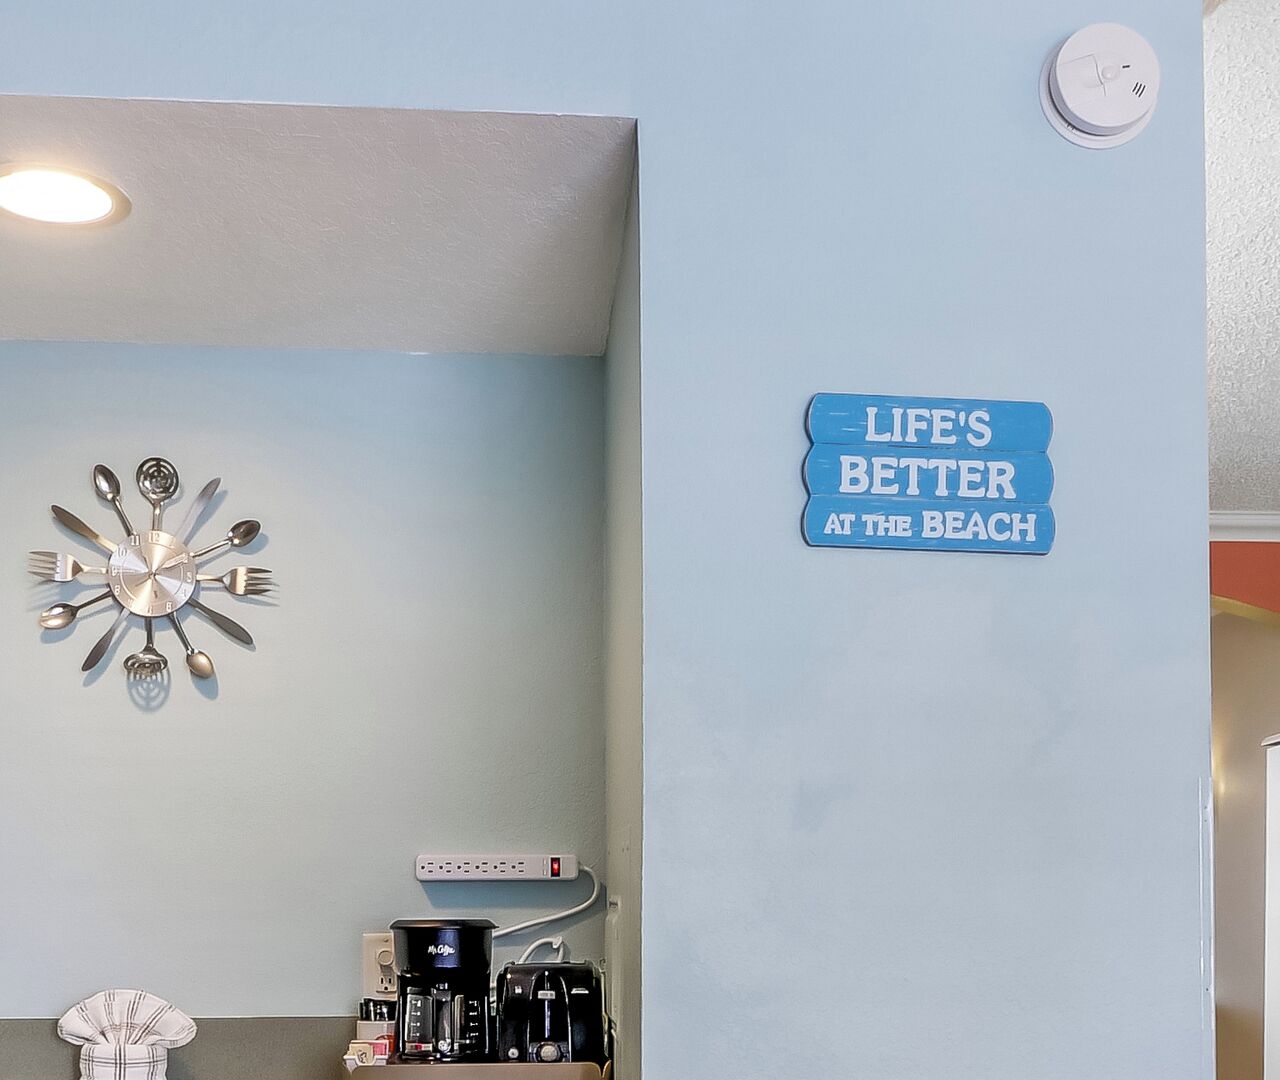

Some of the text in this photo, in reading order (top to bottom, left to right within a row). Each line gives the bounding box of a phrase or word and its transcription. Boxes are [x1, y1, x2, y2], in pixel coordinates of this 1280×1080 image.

[865, 406, 993, 447] LIFE'S
[839, 455, 1016, 499] BETTER
[824, 510, 1037, 542] AT THE BEACH
